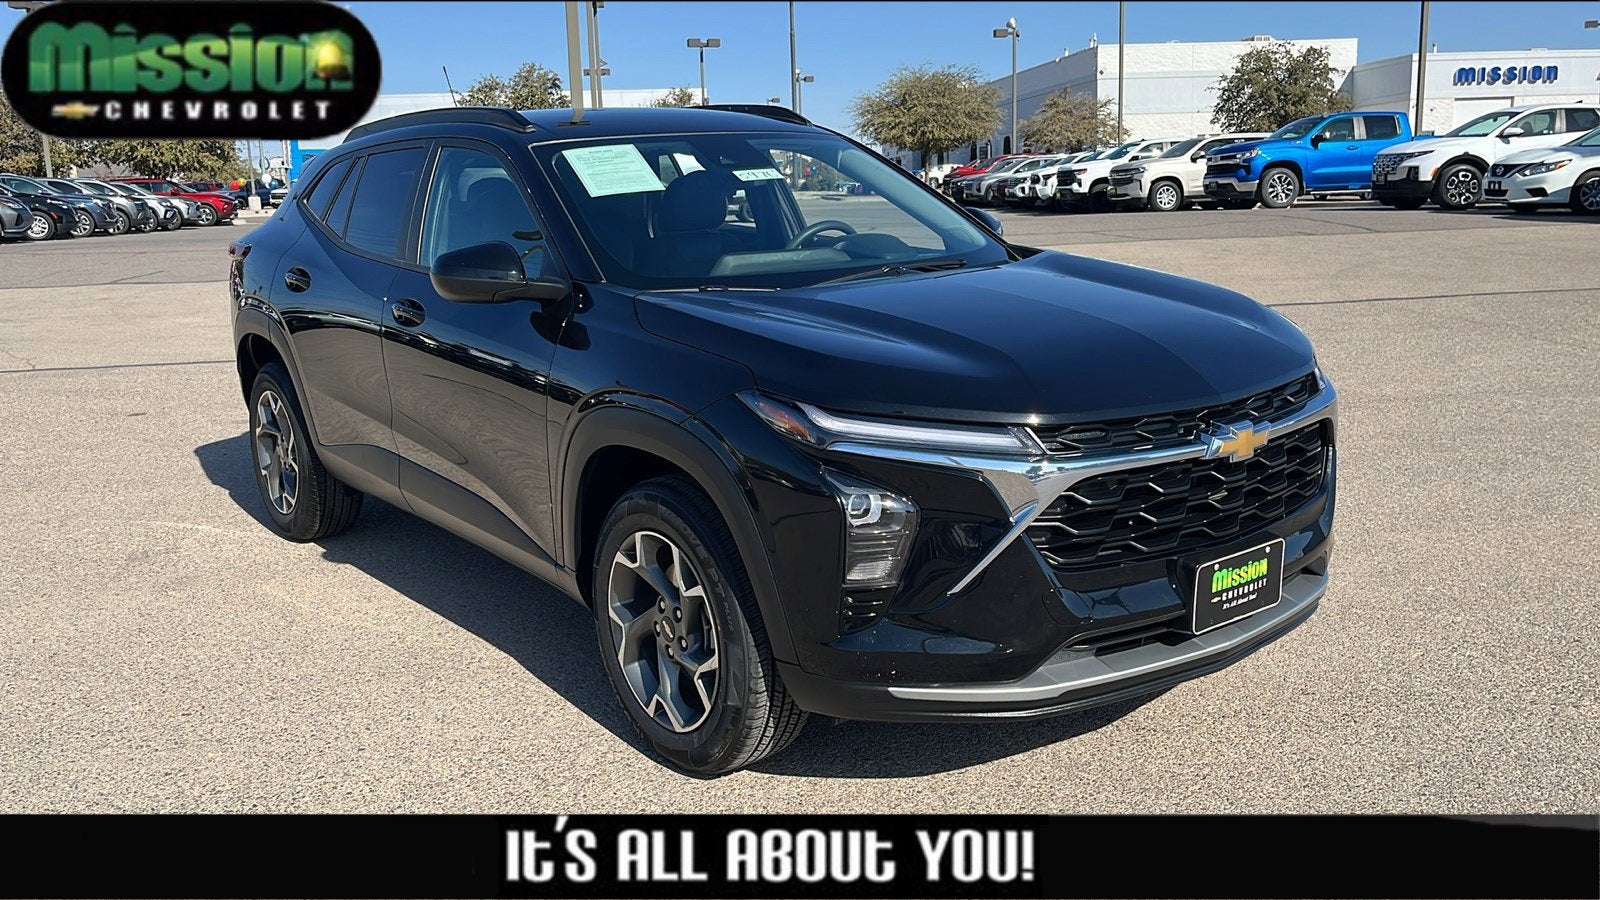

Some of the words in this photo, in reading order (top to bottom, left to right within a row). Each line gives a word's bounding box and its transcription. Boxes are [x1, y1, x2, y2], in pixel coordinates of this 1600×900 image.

[1453, 65, 1558, 85] MISSION
[1211, 558, 1268, 593] Mission
[1221, 578, 1268, 601] CHEVROLET
